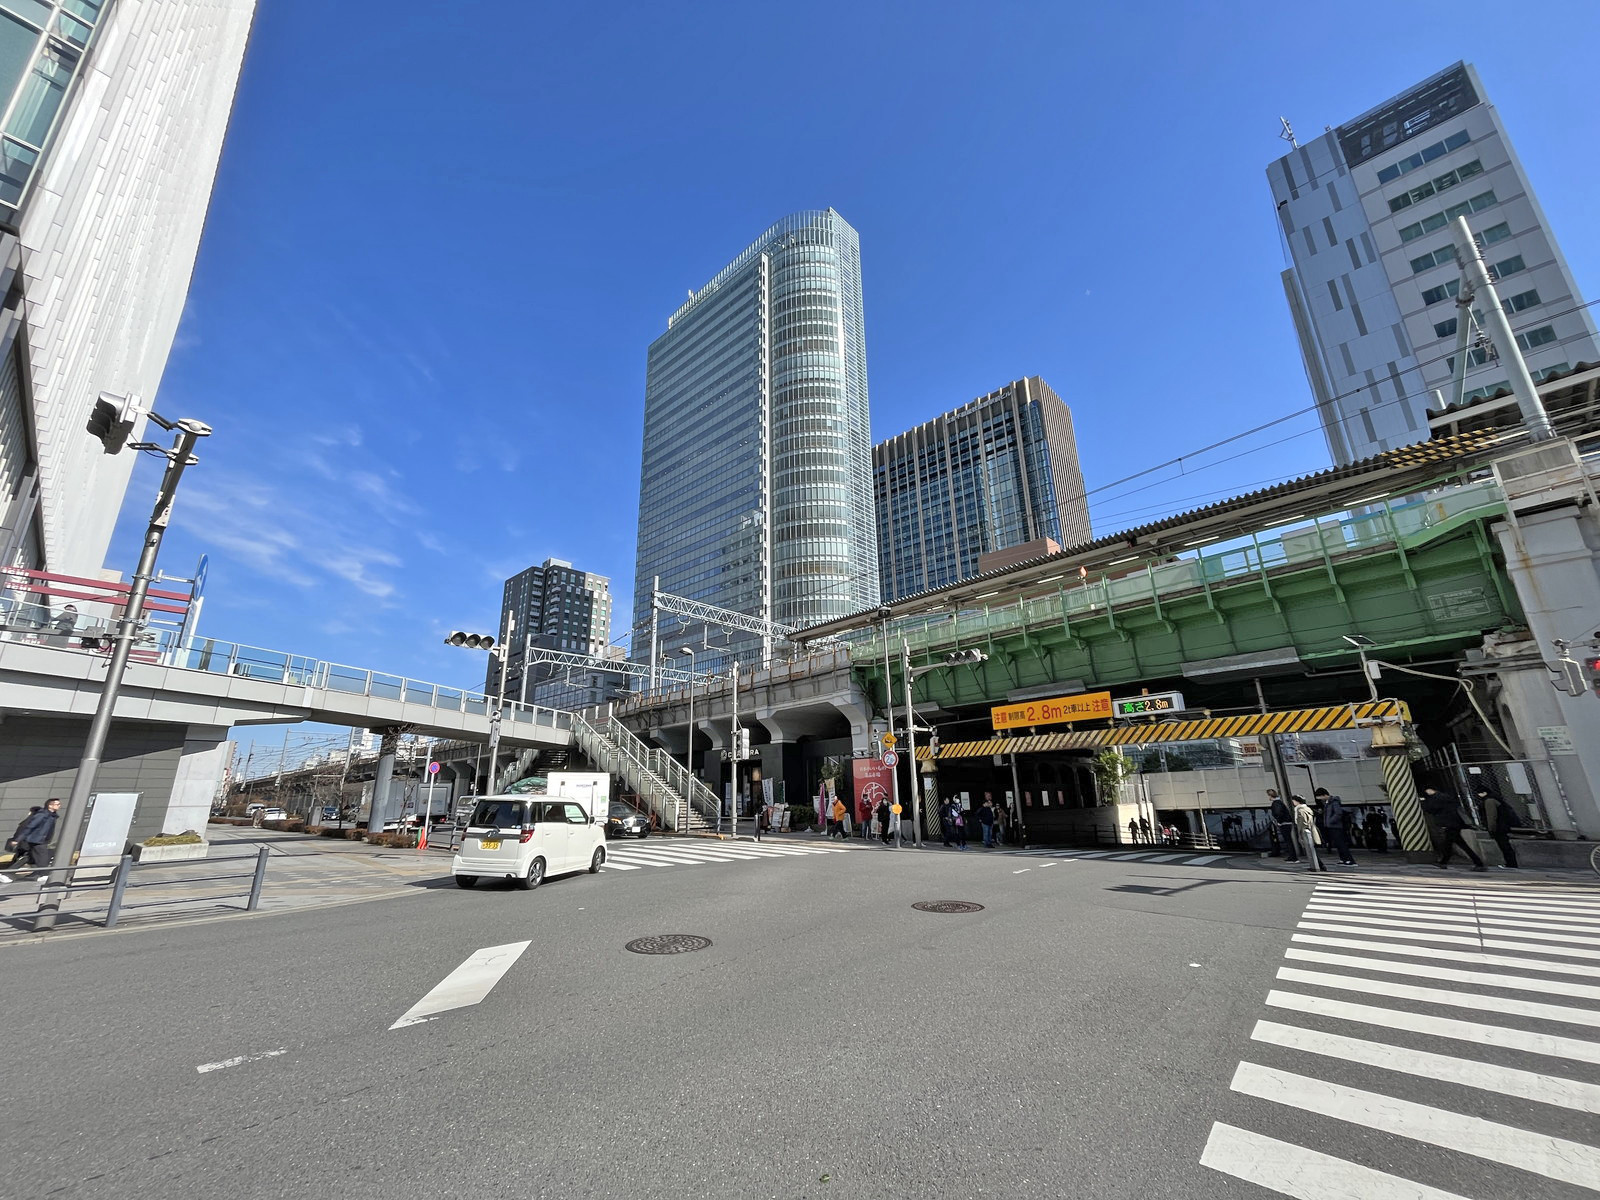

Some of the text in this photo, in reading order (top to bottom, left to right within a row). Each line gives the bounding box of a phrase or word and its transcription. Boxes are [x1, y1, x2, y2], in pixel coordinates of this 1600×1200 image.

[994, 698, 1110, 724] 注意 制限高 2.8m 2t車以上 注意
